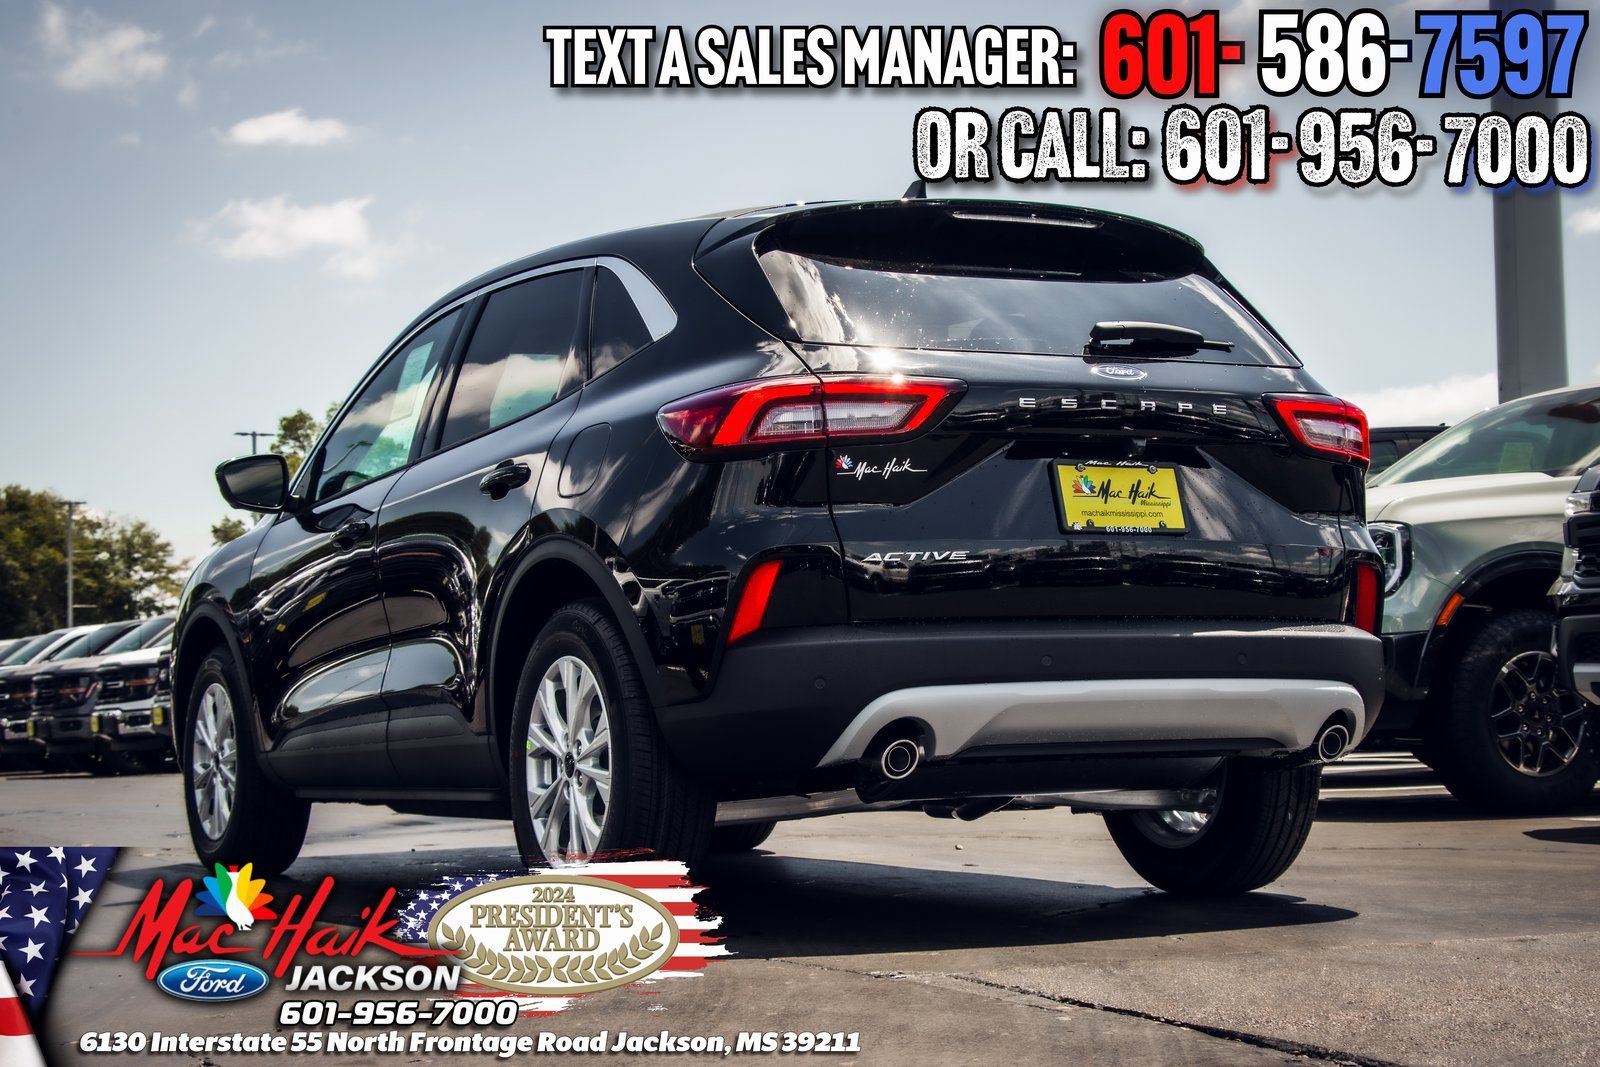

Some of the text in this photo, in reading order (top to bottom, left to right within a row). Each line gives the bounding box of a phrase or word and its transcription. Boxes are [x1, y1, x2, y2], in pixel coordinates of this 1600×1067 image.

[1105, 365, 1136, 376] Ford
[1019, 397, 1228, 415] ESCAPE
[846, 457, 926, 480] Mac Haik
[1088, 478, 1171, 505] Mac Haik
[1140, 499, 1172, 509] Mississippi
[1081, 509, 1164, 519] machaikmississippi.com
[861, 550, 970, 562] ACTIVE
